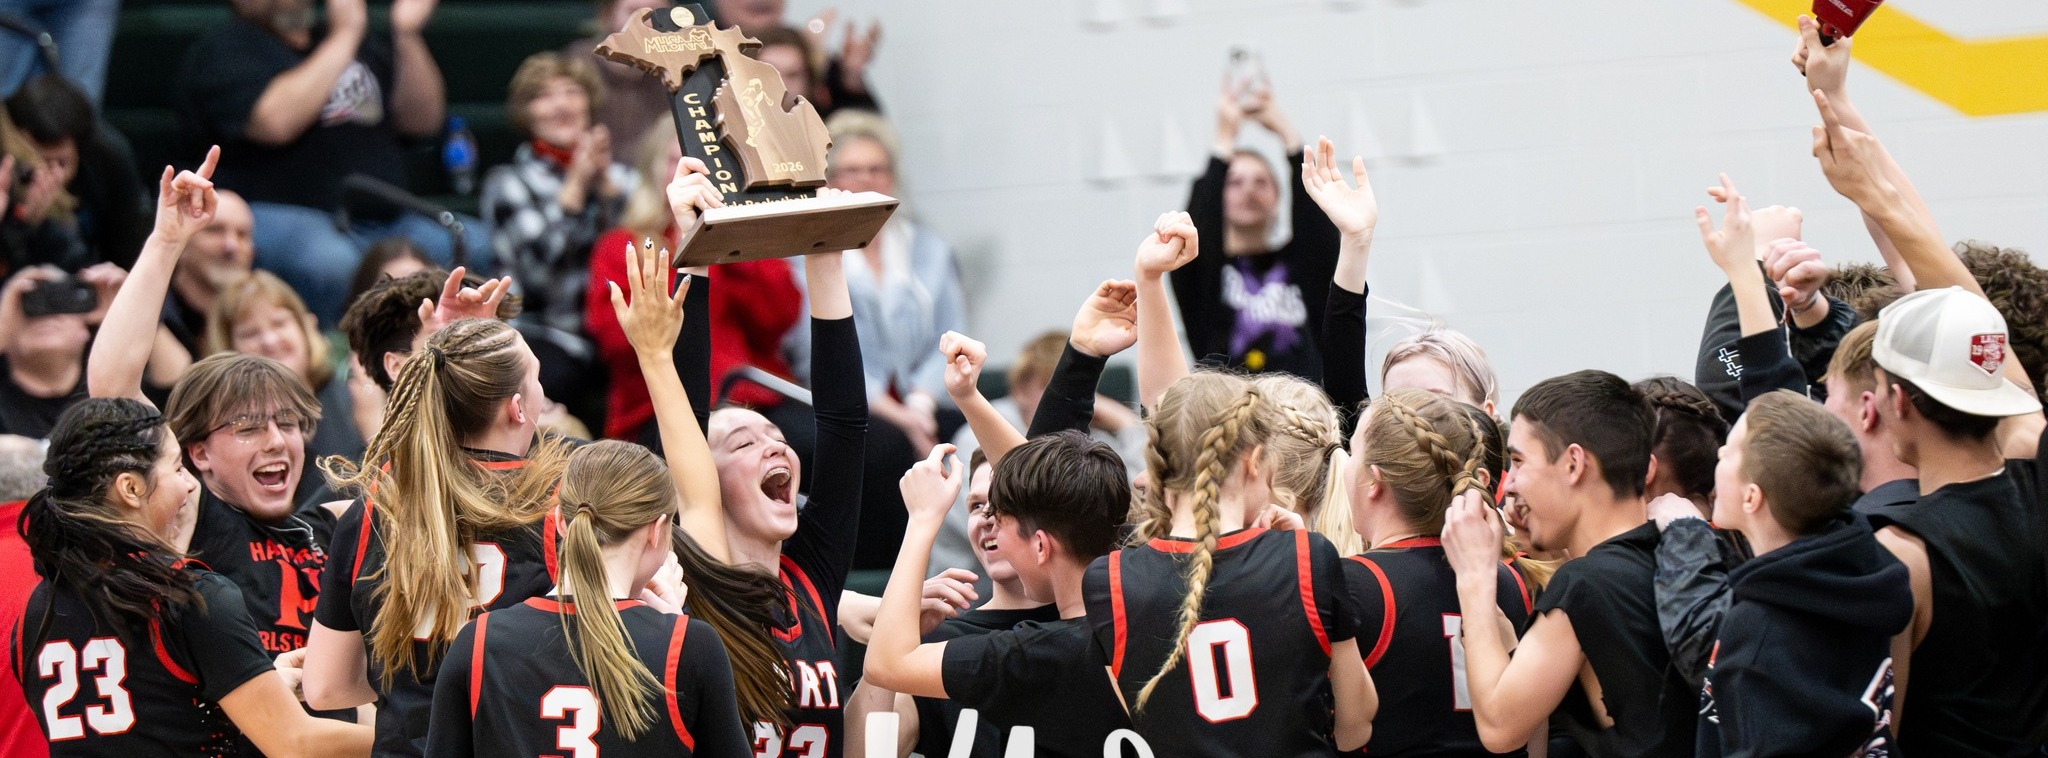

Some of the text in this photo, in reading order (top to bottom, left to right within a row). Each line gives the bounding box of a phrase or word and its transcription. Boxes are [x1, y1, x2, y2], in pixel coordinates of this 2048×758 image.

[683, 93, 738, 194] CHAMPION
[772, 161, 804, 173] 2026
[37, 635, 137, 742] 23
[539, 684, 601, 758] 3
[1186, 617, 1259, 724] 0
